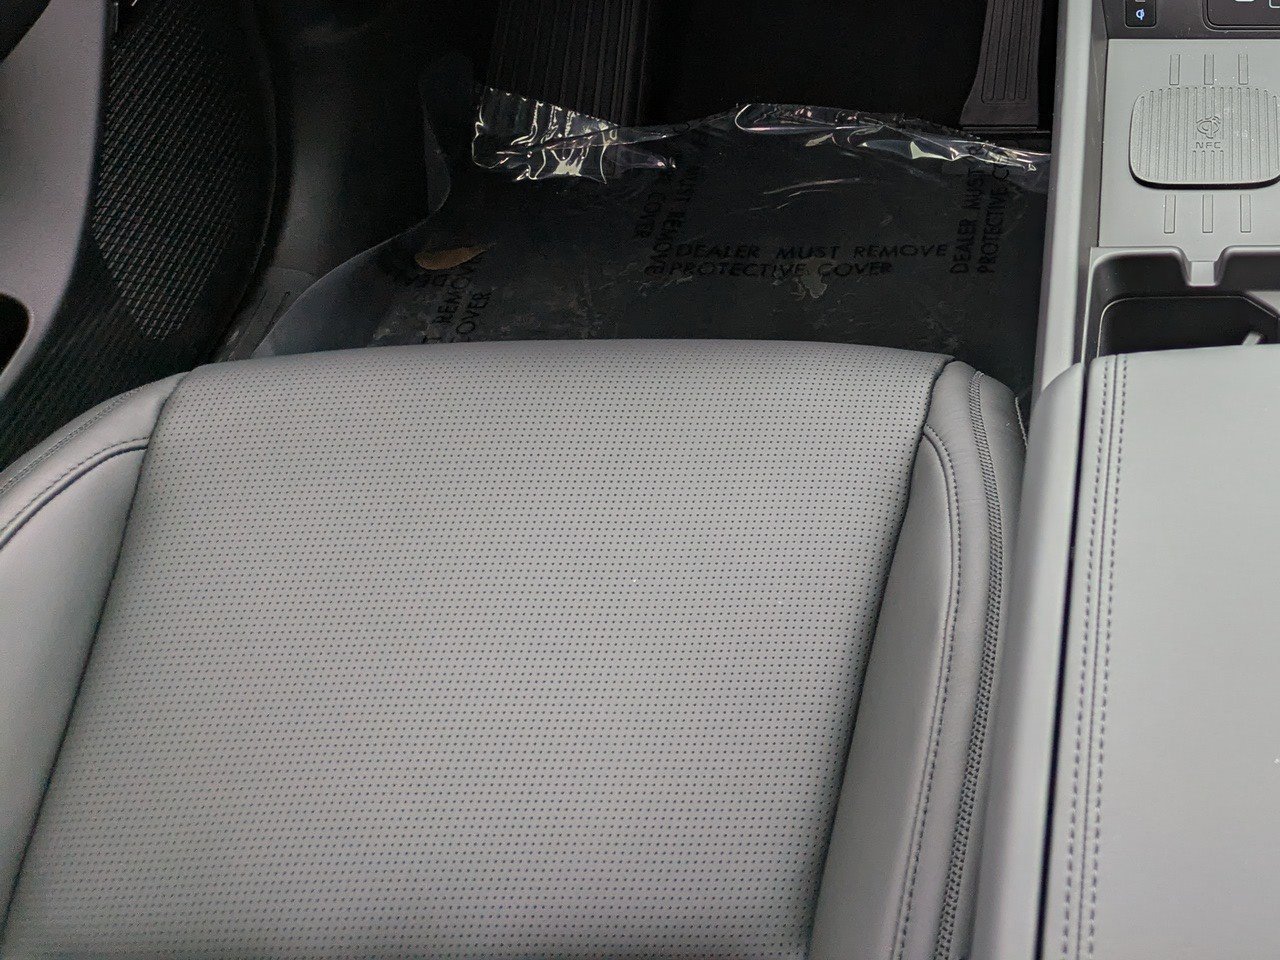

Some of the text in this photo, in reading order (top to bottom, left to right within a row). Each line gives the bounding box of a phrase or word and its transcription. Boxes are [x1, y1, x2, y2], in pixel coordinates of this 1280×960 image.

[1196, 141, 1221, 150] NFC
[675, 243, 947, 259] DEALER MUST REMOVE
[670, 261, 892, 278] PROTECTIVE COVER
[456, 290, 494, 337] OVER
